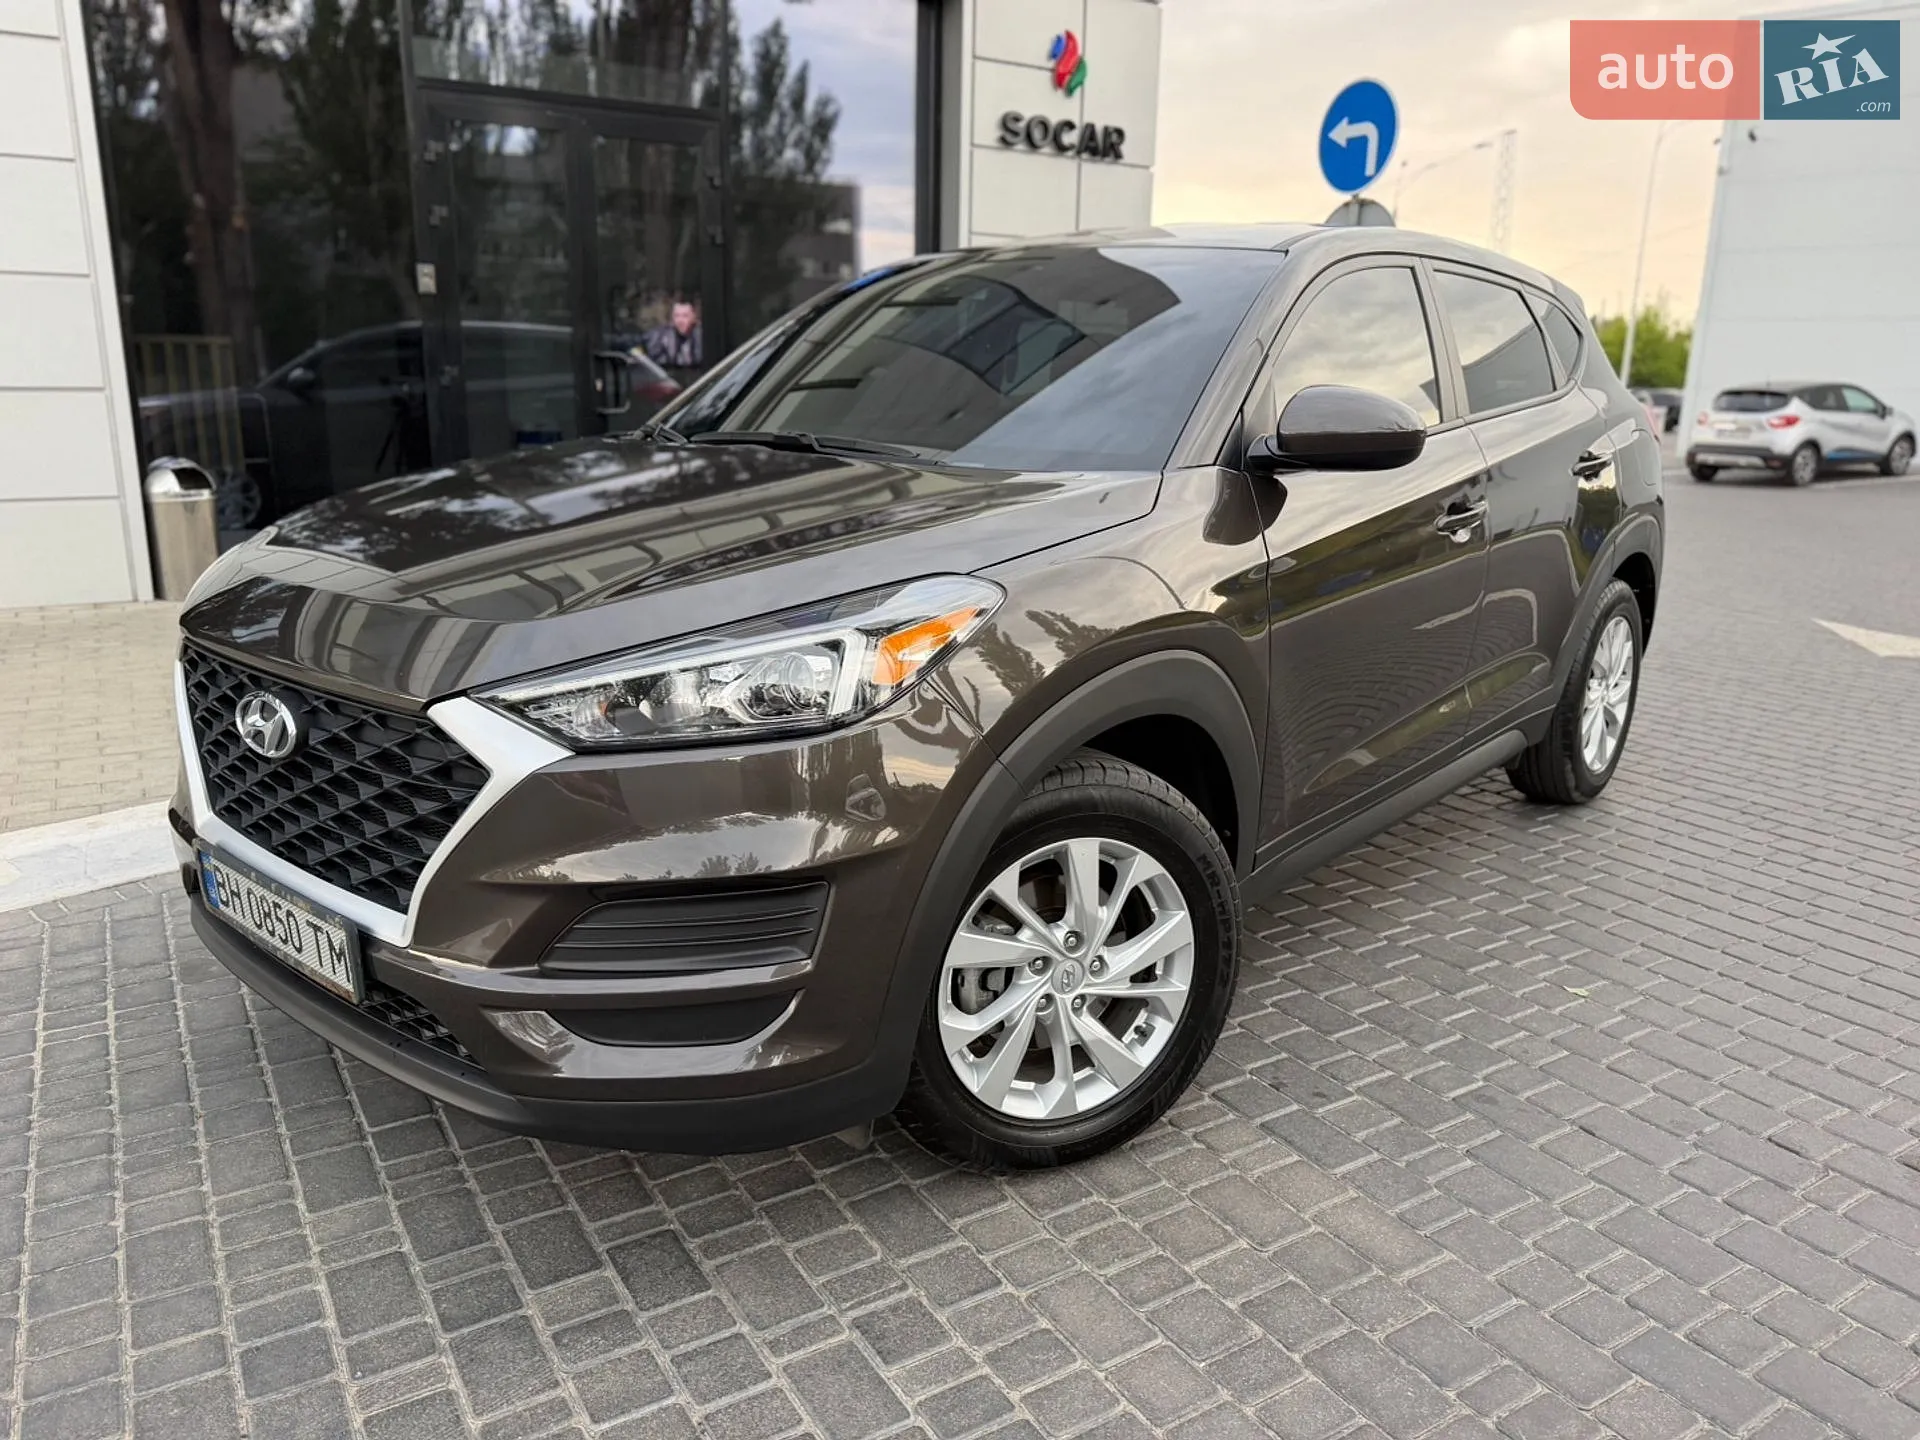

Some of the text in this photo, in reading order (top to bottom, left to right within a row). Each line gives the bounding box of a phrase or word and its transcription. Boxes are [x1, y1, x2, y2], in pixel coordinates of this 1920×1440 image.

[998, 111, 1125, 160] SOCAR
[213, 863, 246, 919] BH
[247, 887, 303, 954] 0850
[306, 918, 351, 983] TM
